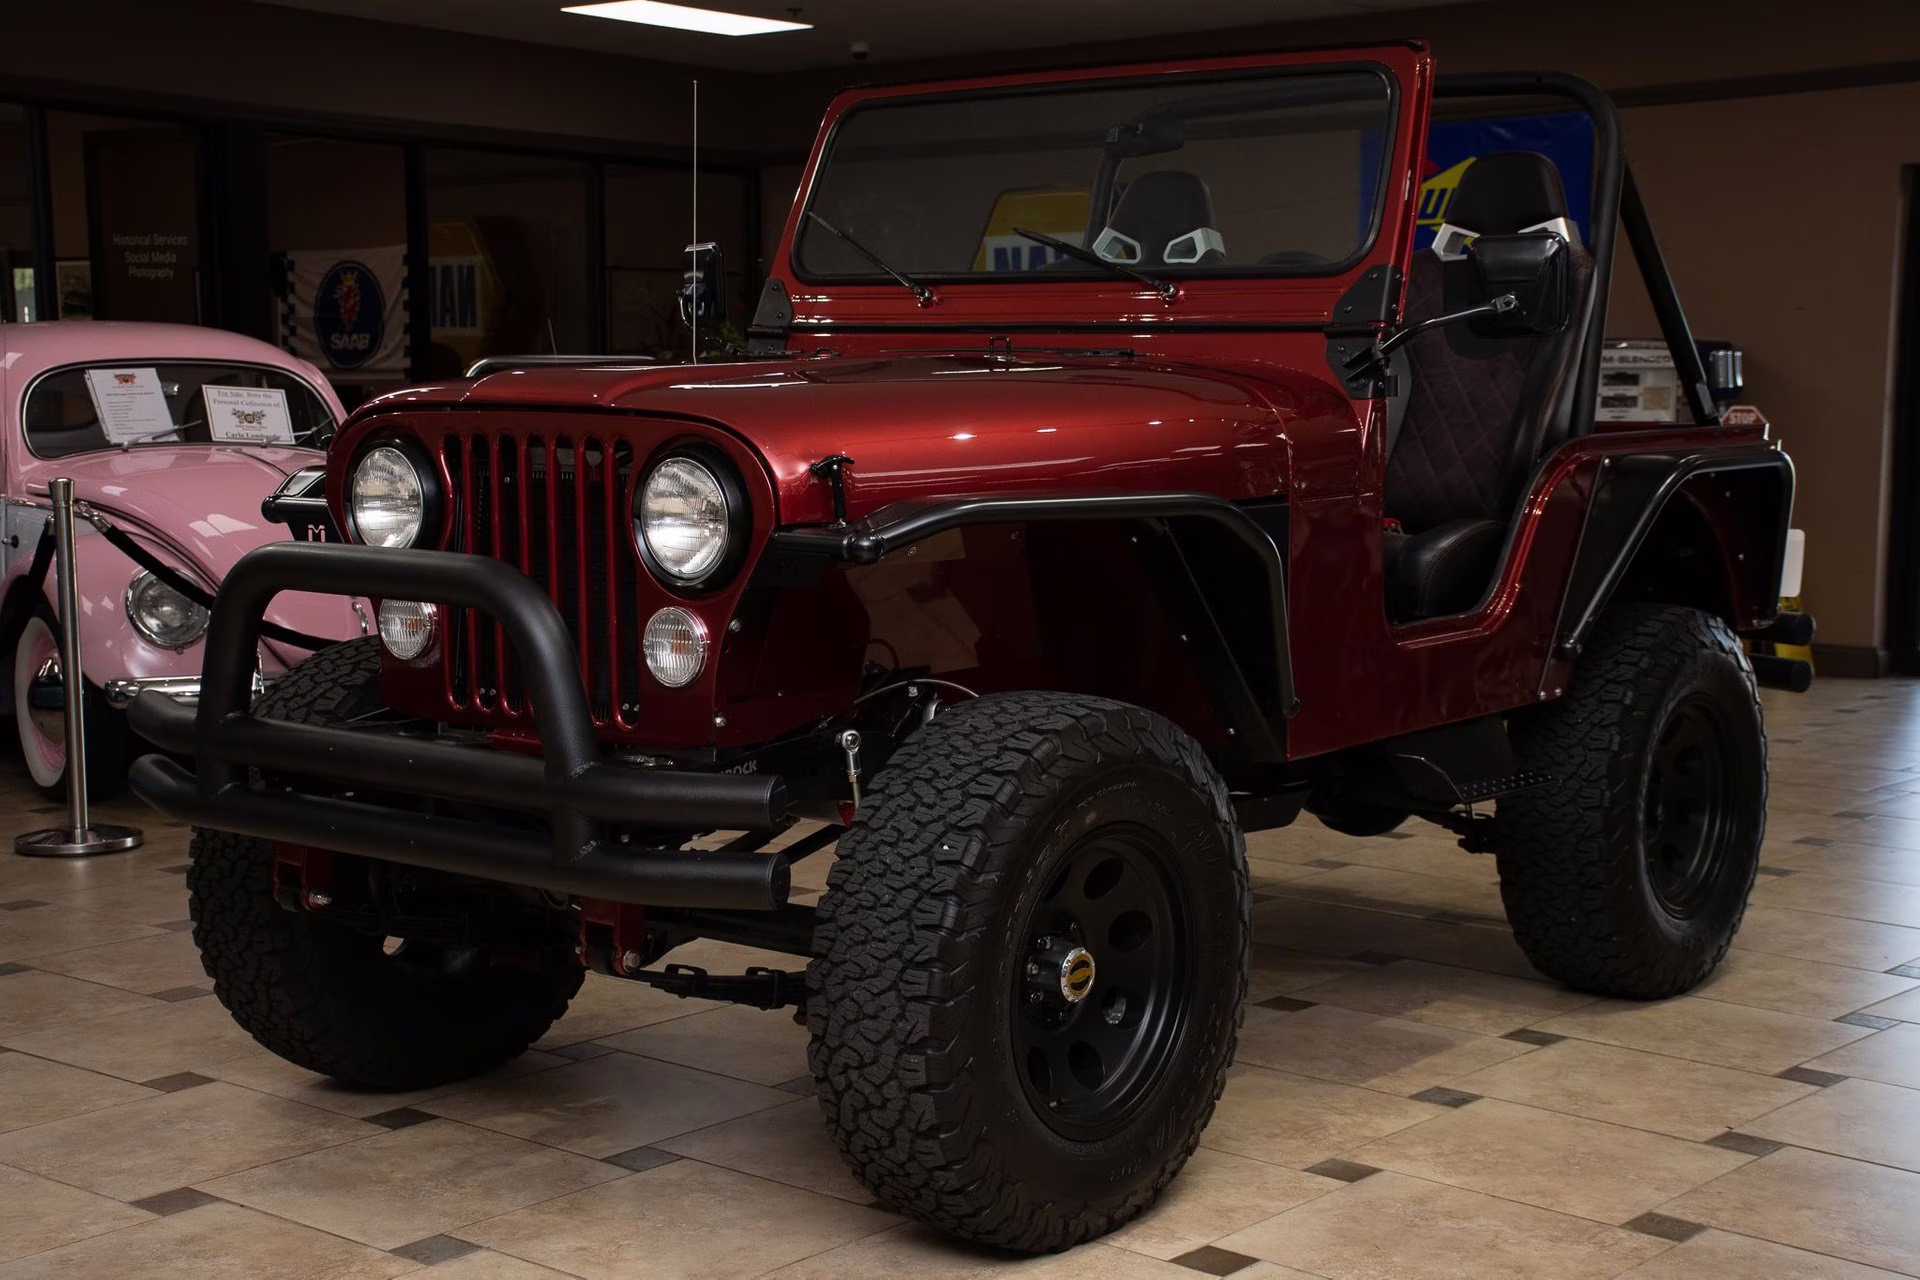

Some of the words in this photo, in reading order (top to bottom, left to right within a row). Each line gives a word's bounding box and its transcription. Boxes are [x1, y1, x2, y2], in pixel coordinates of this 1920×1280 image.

[112, 233, 151, 246] Historical
[153, 233, 188, 246] Services
[124, 251, 149, 263] Social
[151, 251, 176, 263] Media
[128, 265, 175, 280] Photography
[330, 332, 370, 351] SAAB
[1729, 412, 1757, 425] STOP
